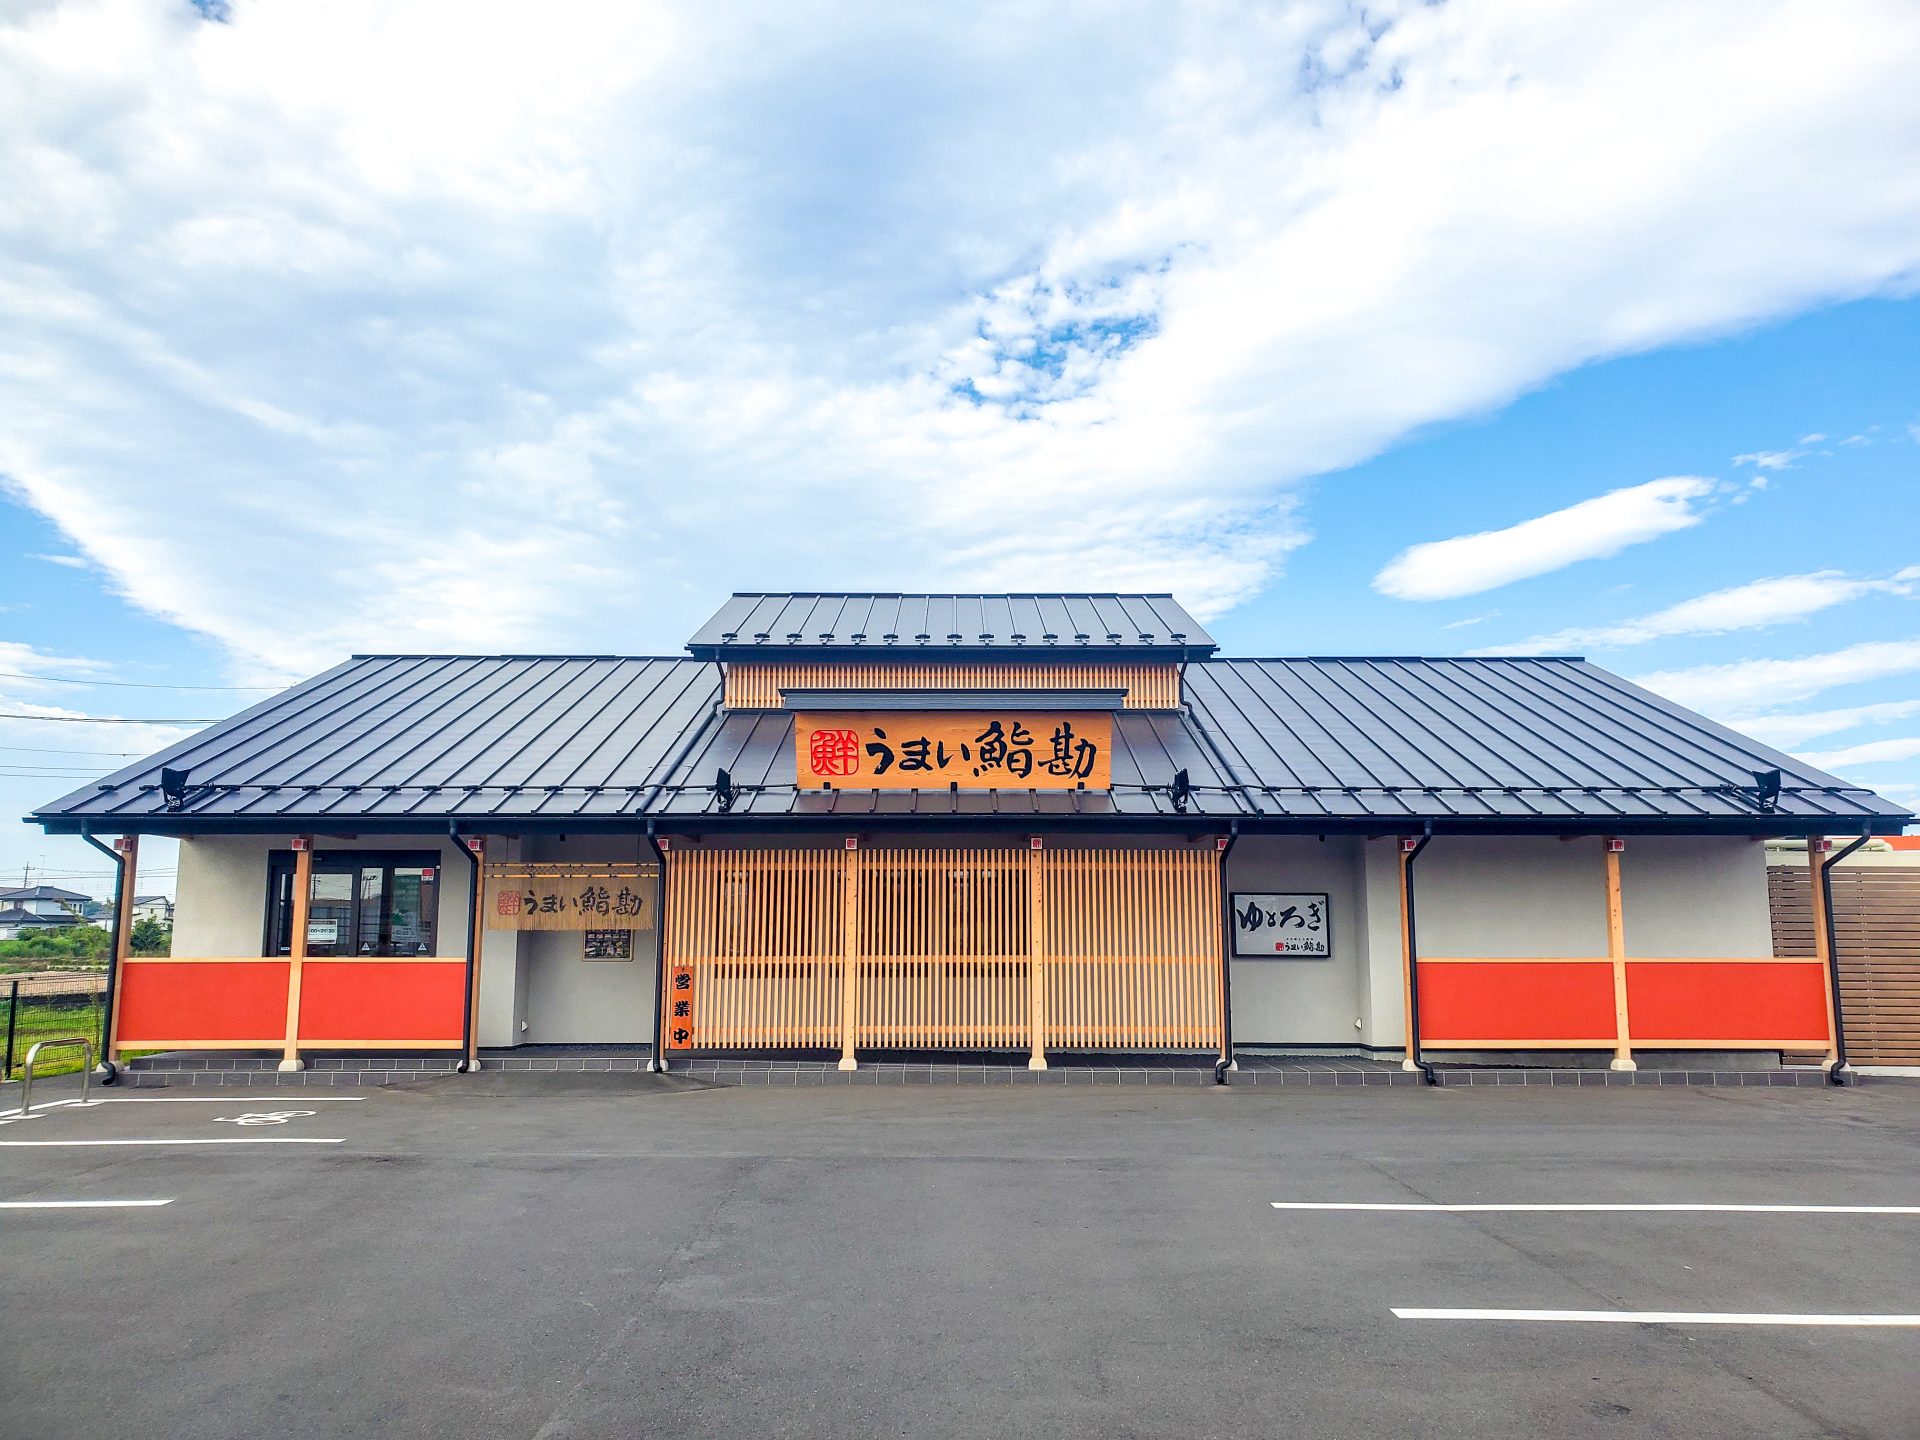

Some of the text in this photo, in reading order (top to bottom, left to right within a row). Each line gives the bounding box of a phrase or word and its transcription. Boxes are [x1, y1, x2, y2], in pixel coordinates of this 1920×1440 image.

[865, 720, 1097, 779] うまい鮨勘
[523, 886, 643, 917] うまい鮨勘
[674, 973, 691, 1044] 営業中
